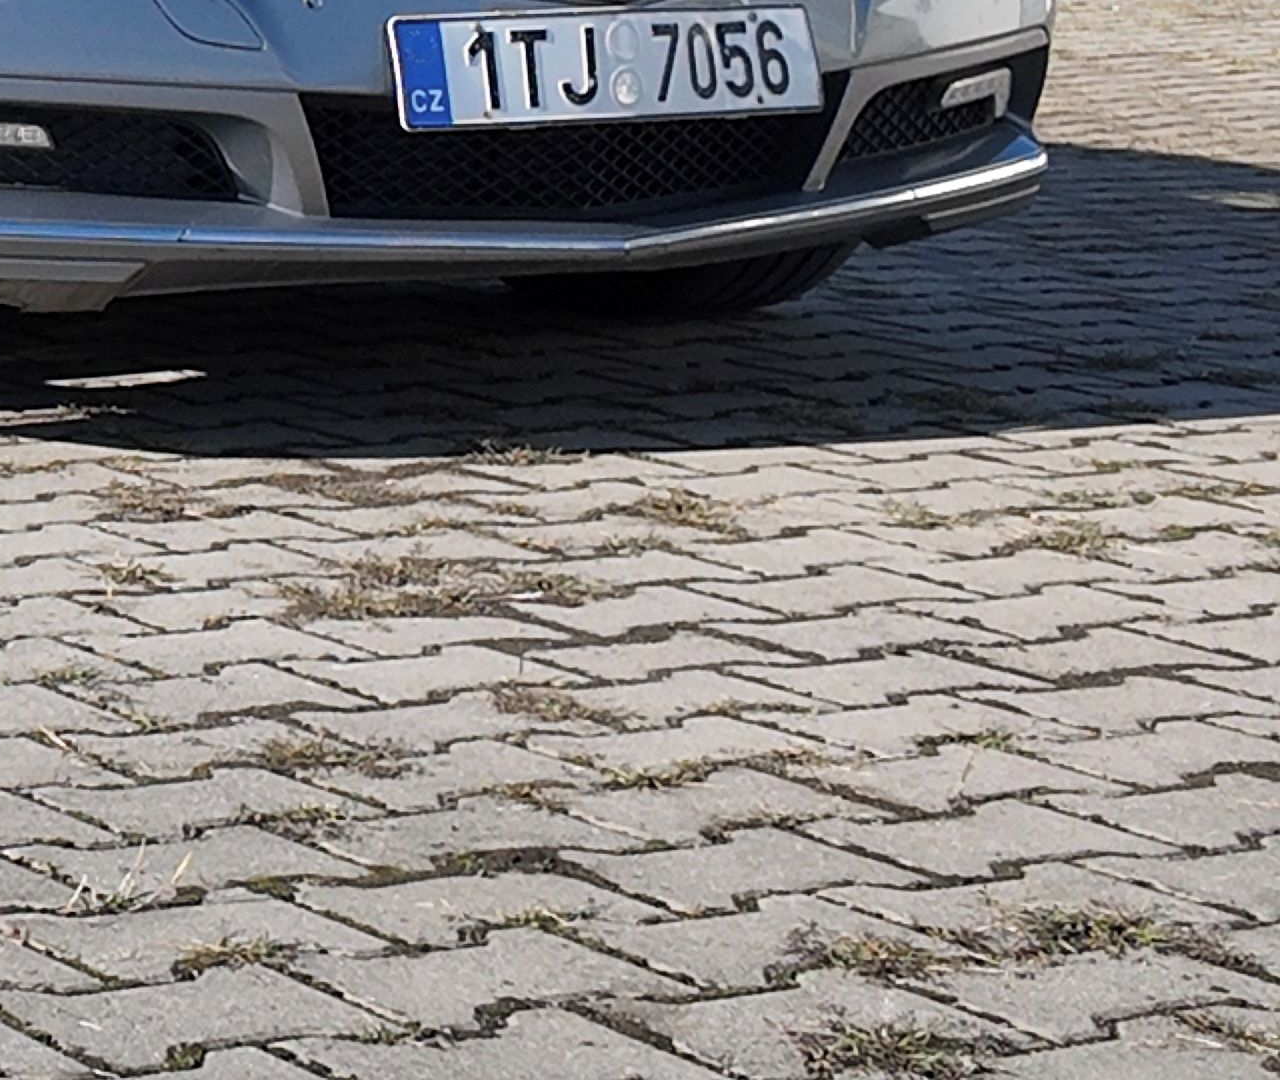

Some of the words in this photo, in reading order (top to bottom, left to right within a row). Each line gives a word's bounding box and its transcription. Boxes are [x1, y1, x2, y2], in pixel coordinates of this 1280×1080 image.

[463, 24, 600, 111] 1TJ
[650, 19, 791, 104] 7056
[410, 88, 445, 113] CZ
